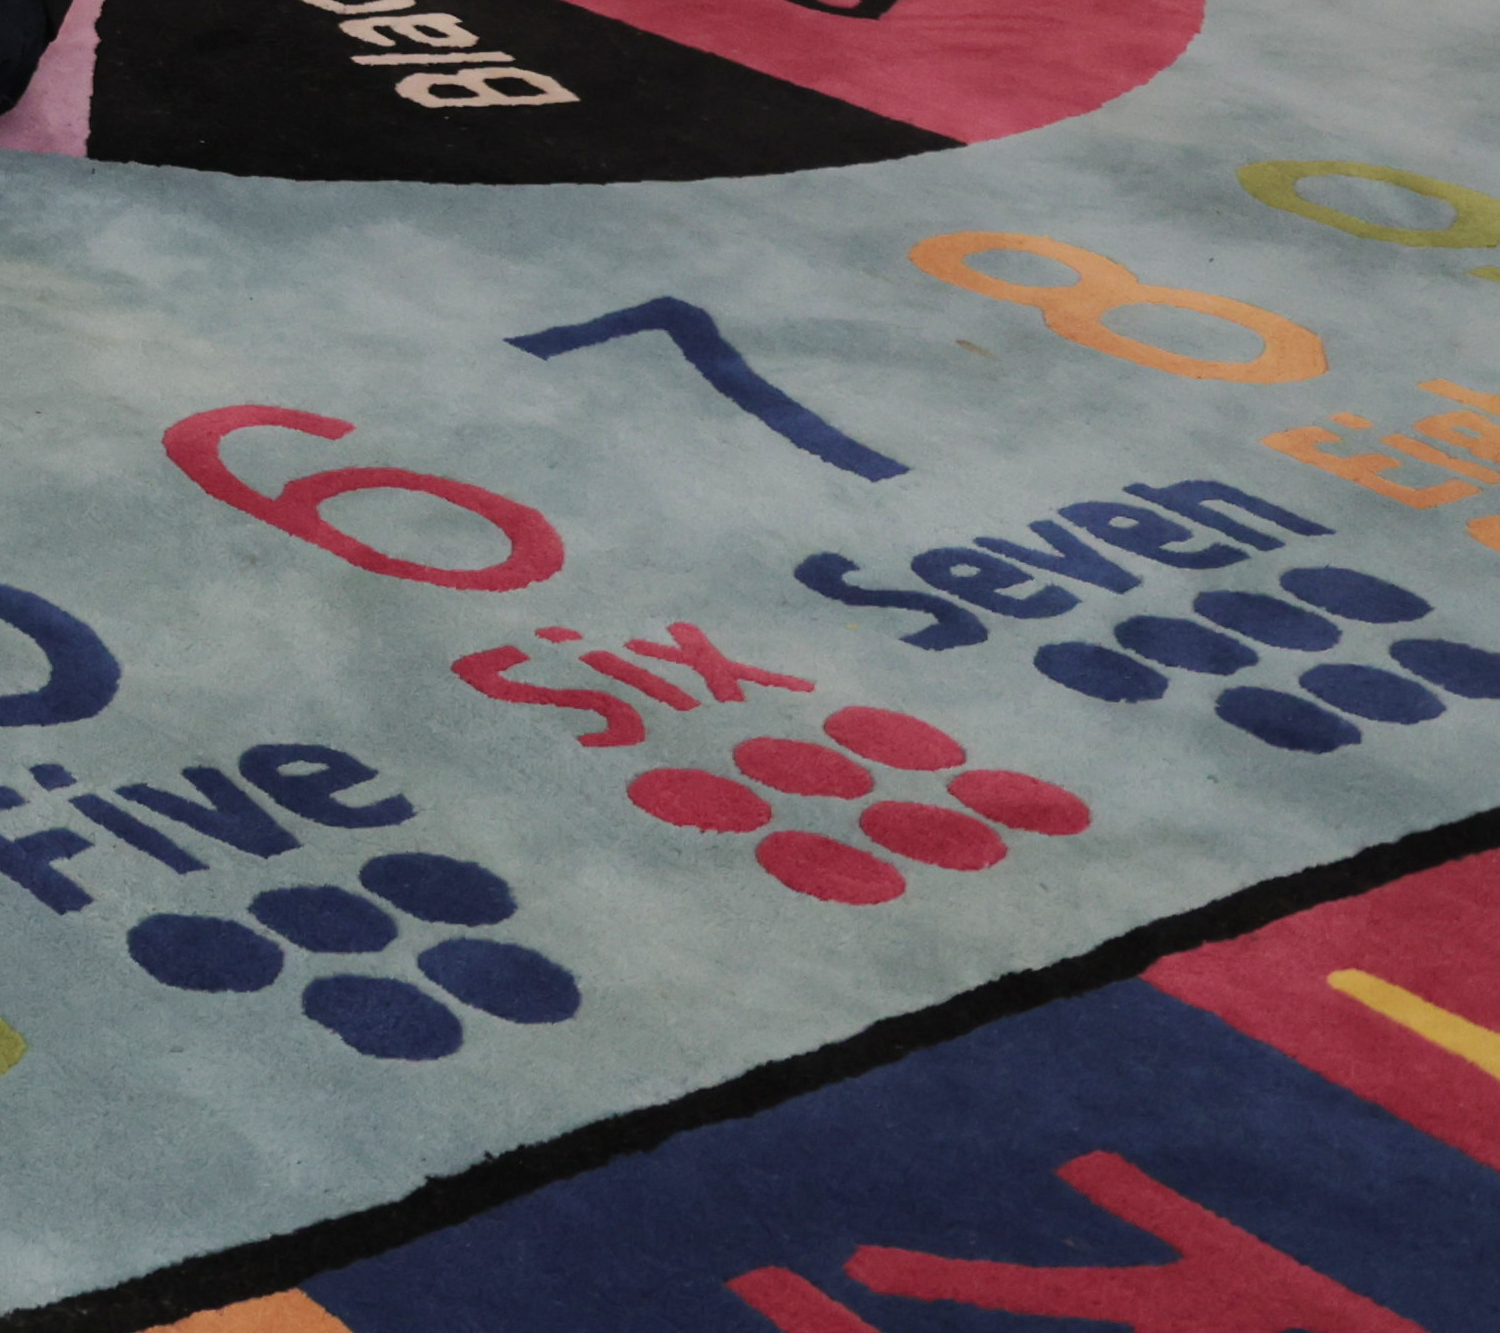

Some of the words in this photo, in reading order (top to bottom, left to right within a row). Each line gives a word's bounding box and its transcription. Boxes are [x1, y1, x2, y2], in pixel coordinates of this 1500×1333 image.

[503, 296, 911, 482] 7
[908, 231, 1330, 385] 8
[162, 403, 565, 592] 6
[794, 479, 1336, 651] Seven
[451, 621, 816, 748] Six
